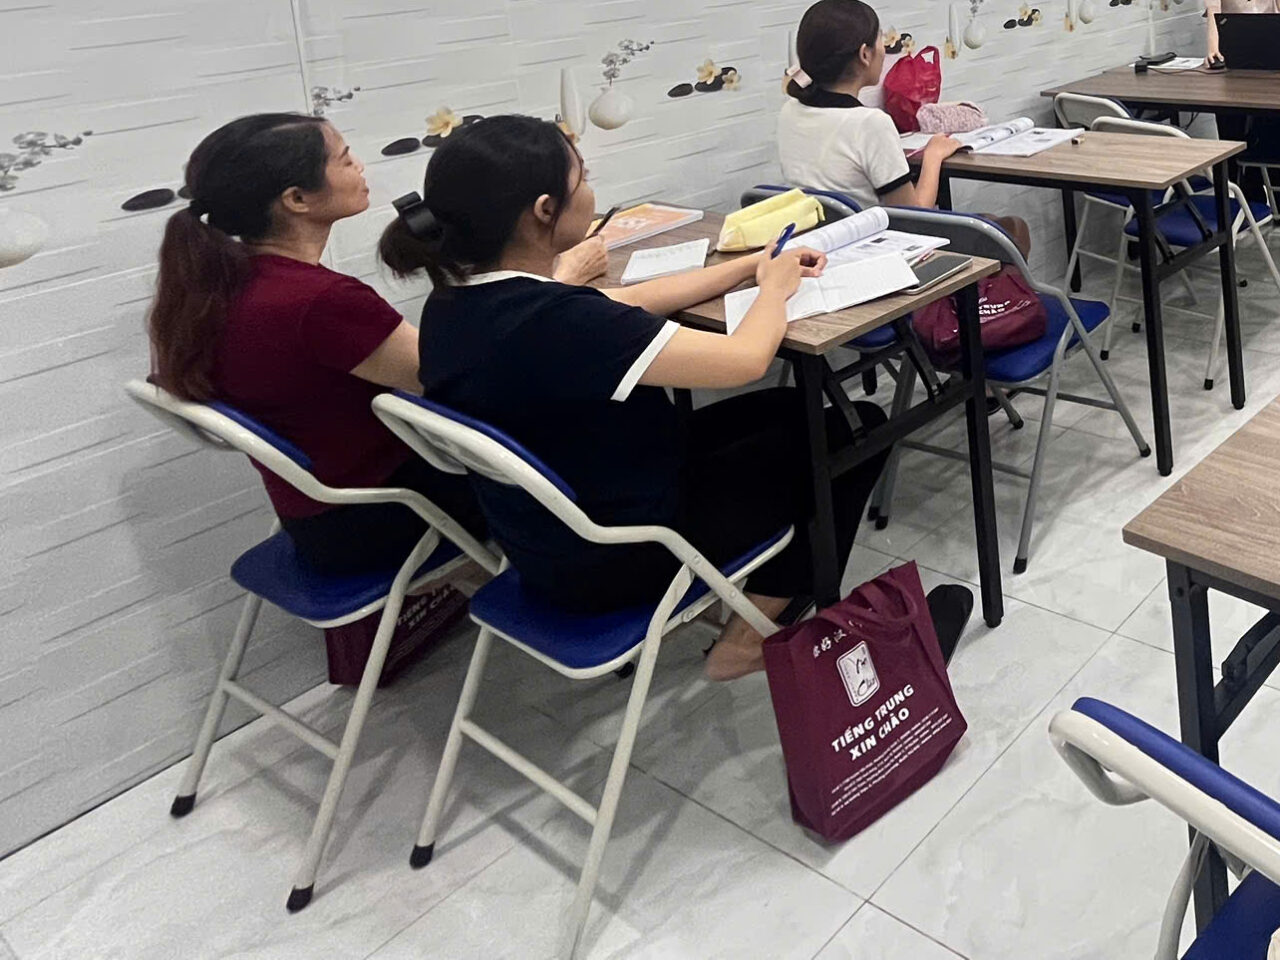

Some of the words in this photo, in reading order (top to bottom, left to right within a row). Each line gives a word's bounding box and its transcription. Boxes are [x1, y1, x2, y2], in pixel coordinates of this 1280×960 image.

[831, 716, 874, 752] TIẾNG
[875, 684, 914, 721] TRUNG
[849, 734, 877, 761] XIN
[878, 707, 910, 739] CHÀO
